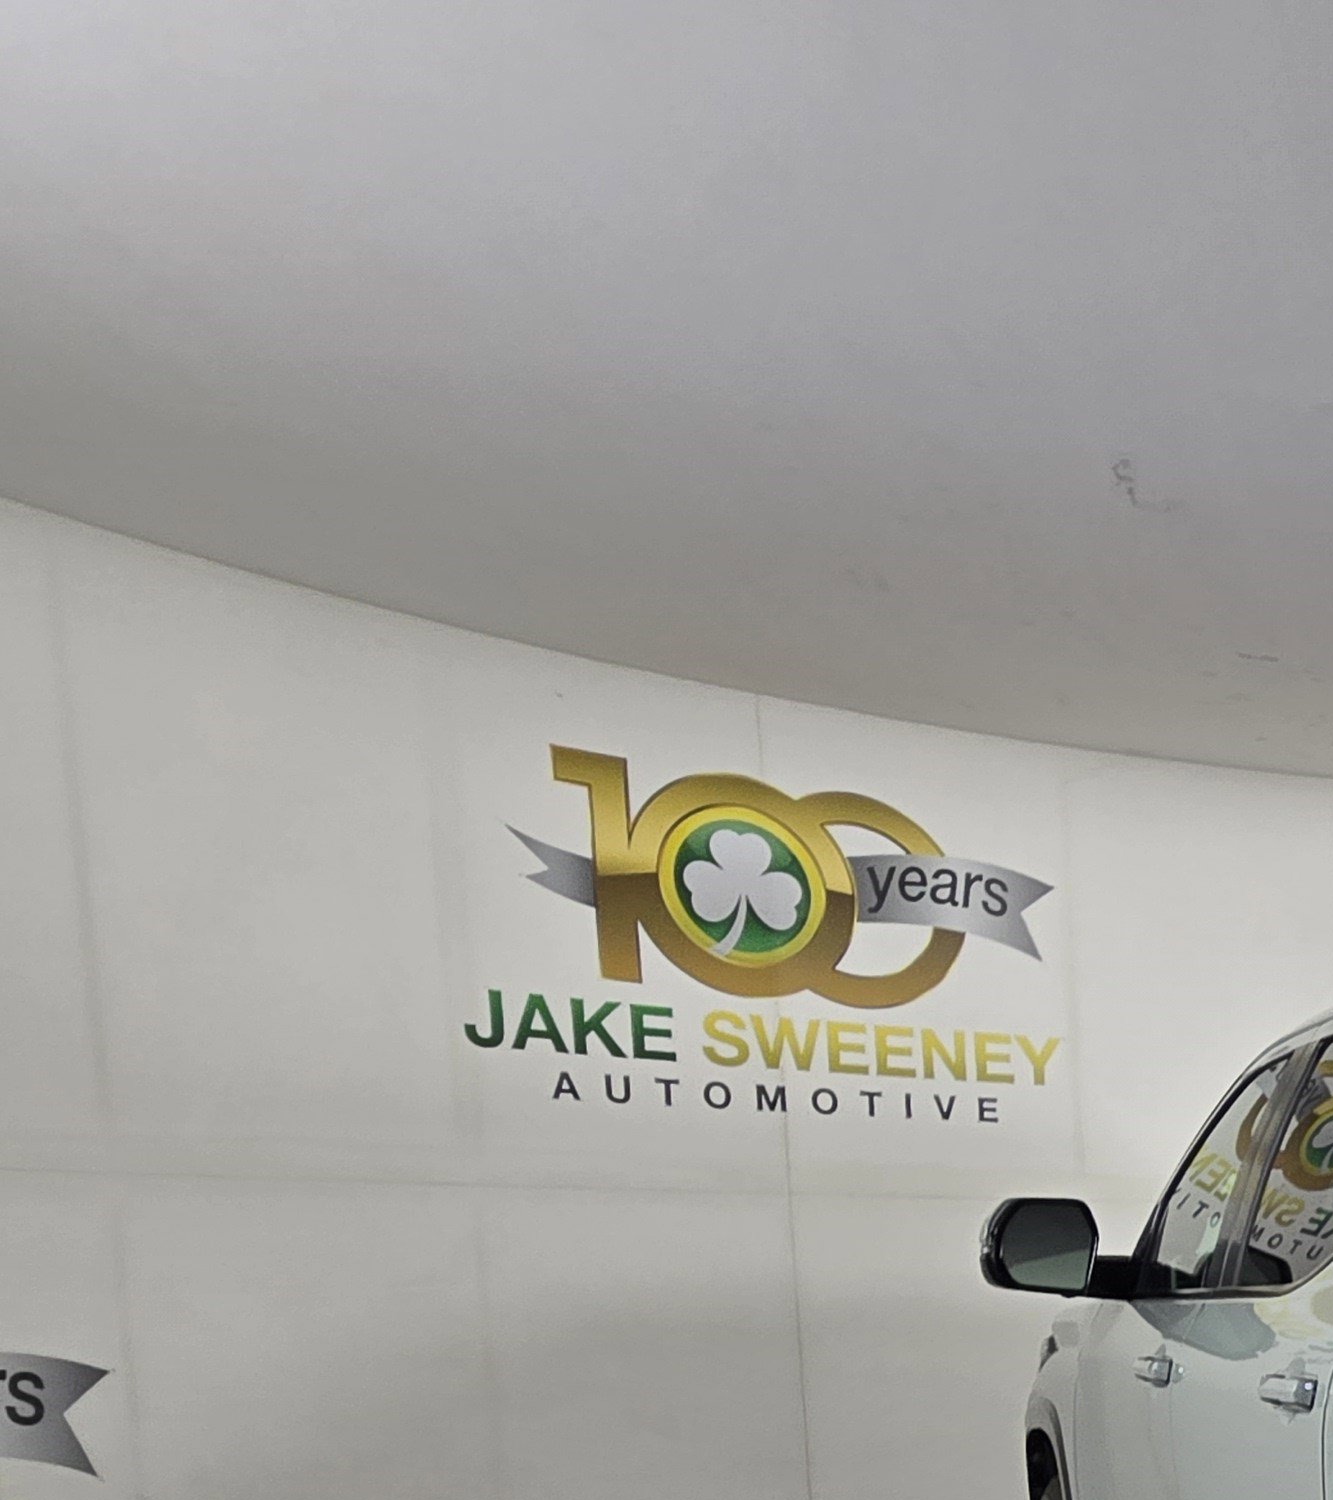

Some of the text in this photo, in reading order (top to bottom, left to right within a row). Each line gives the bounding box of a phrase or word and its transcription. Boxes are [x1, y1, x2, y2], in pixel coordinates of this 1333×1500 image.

[865, 863, 1010, 917] years
[463, 988, 1061, 1088] JAKE SWEENEY
[552, 1071, 1001, 1124] AUTOMOTIVE
